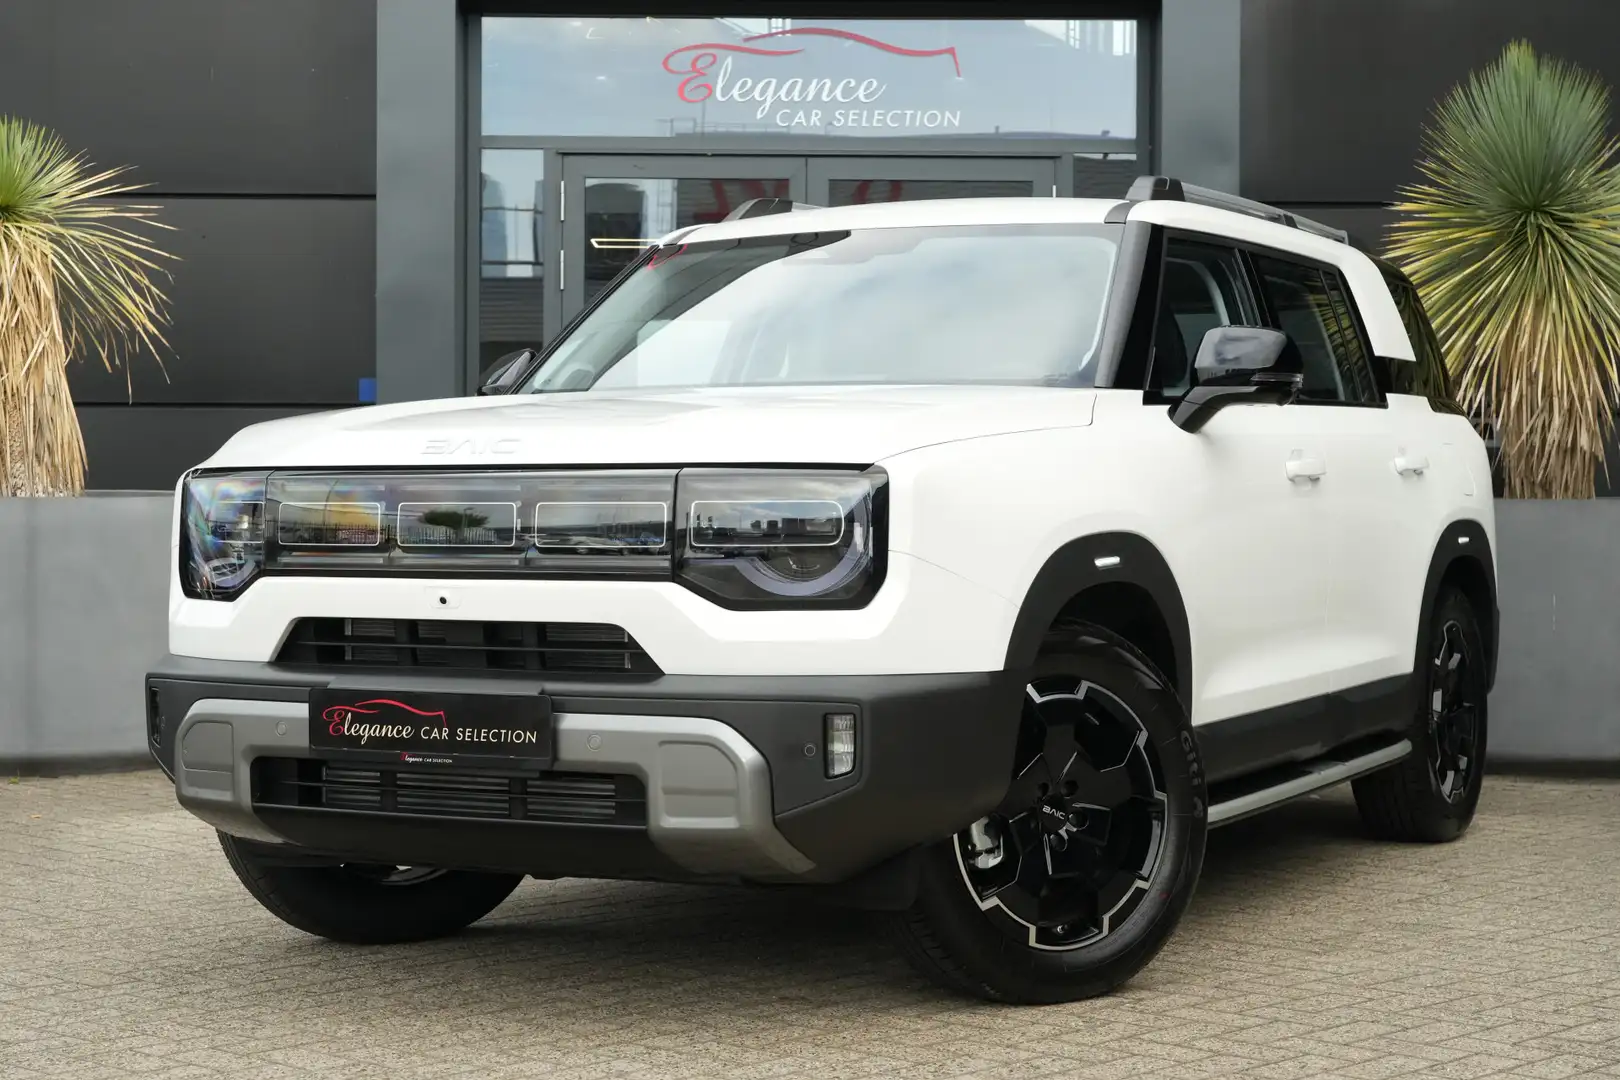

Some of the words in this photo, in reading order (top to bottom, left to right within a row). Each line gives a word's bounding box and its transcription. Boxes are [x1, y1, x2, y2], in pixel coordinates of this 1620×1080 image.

[662, 44, 887, 119] Elegance
[776, 109, 821, 127] CAR
[833, 110, 961, 127] SELECTION
[322, 706, 415, 745] Elegance
[420, 726, 449, 740] CAR
[456, 727, 537, 743] SELECTION
